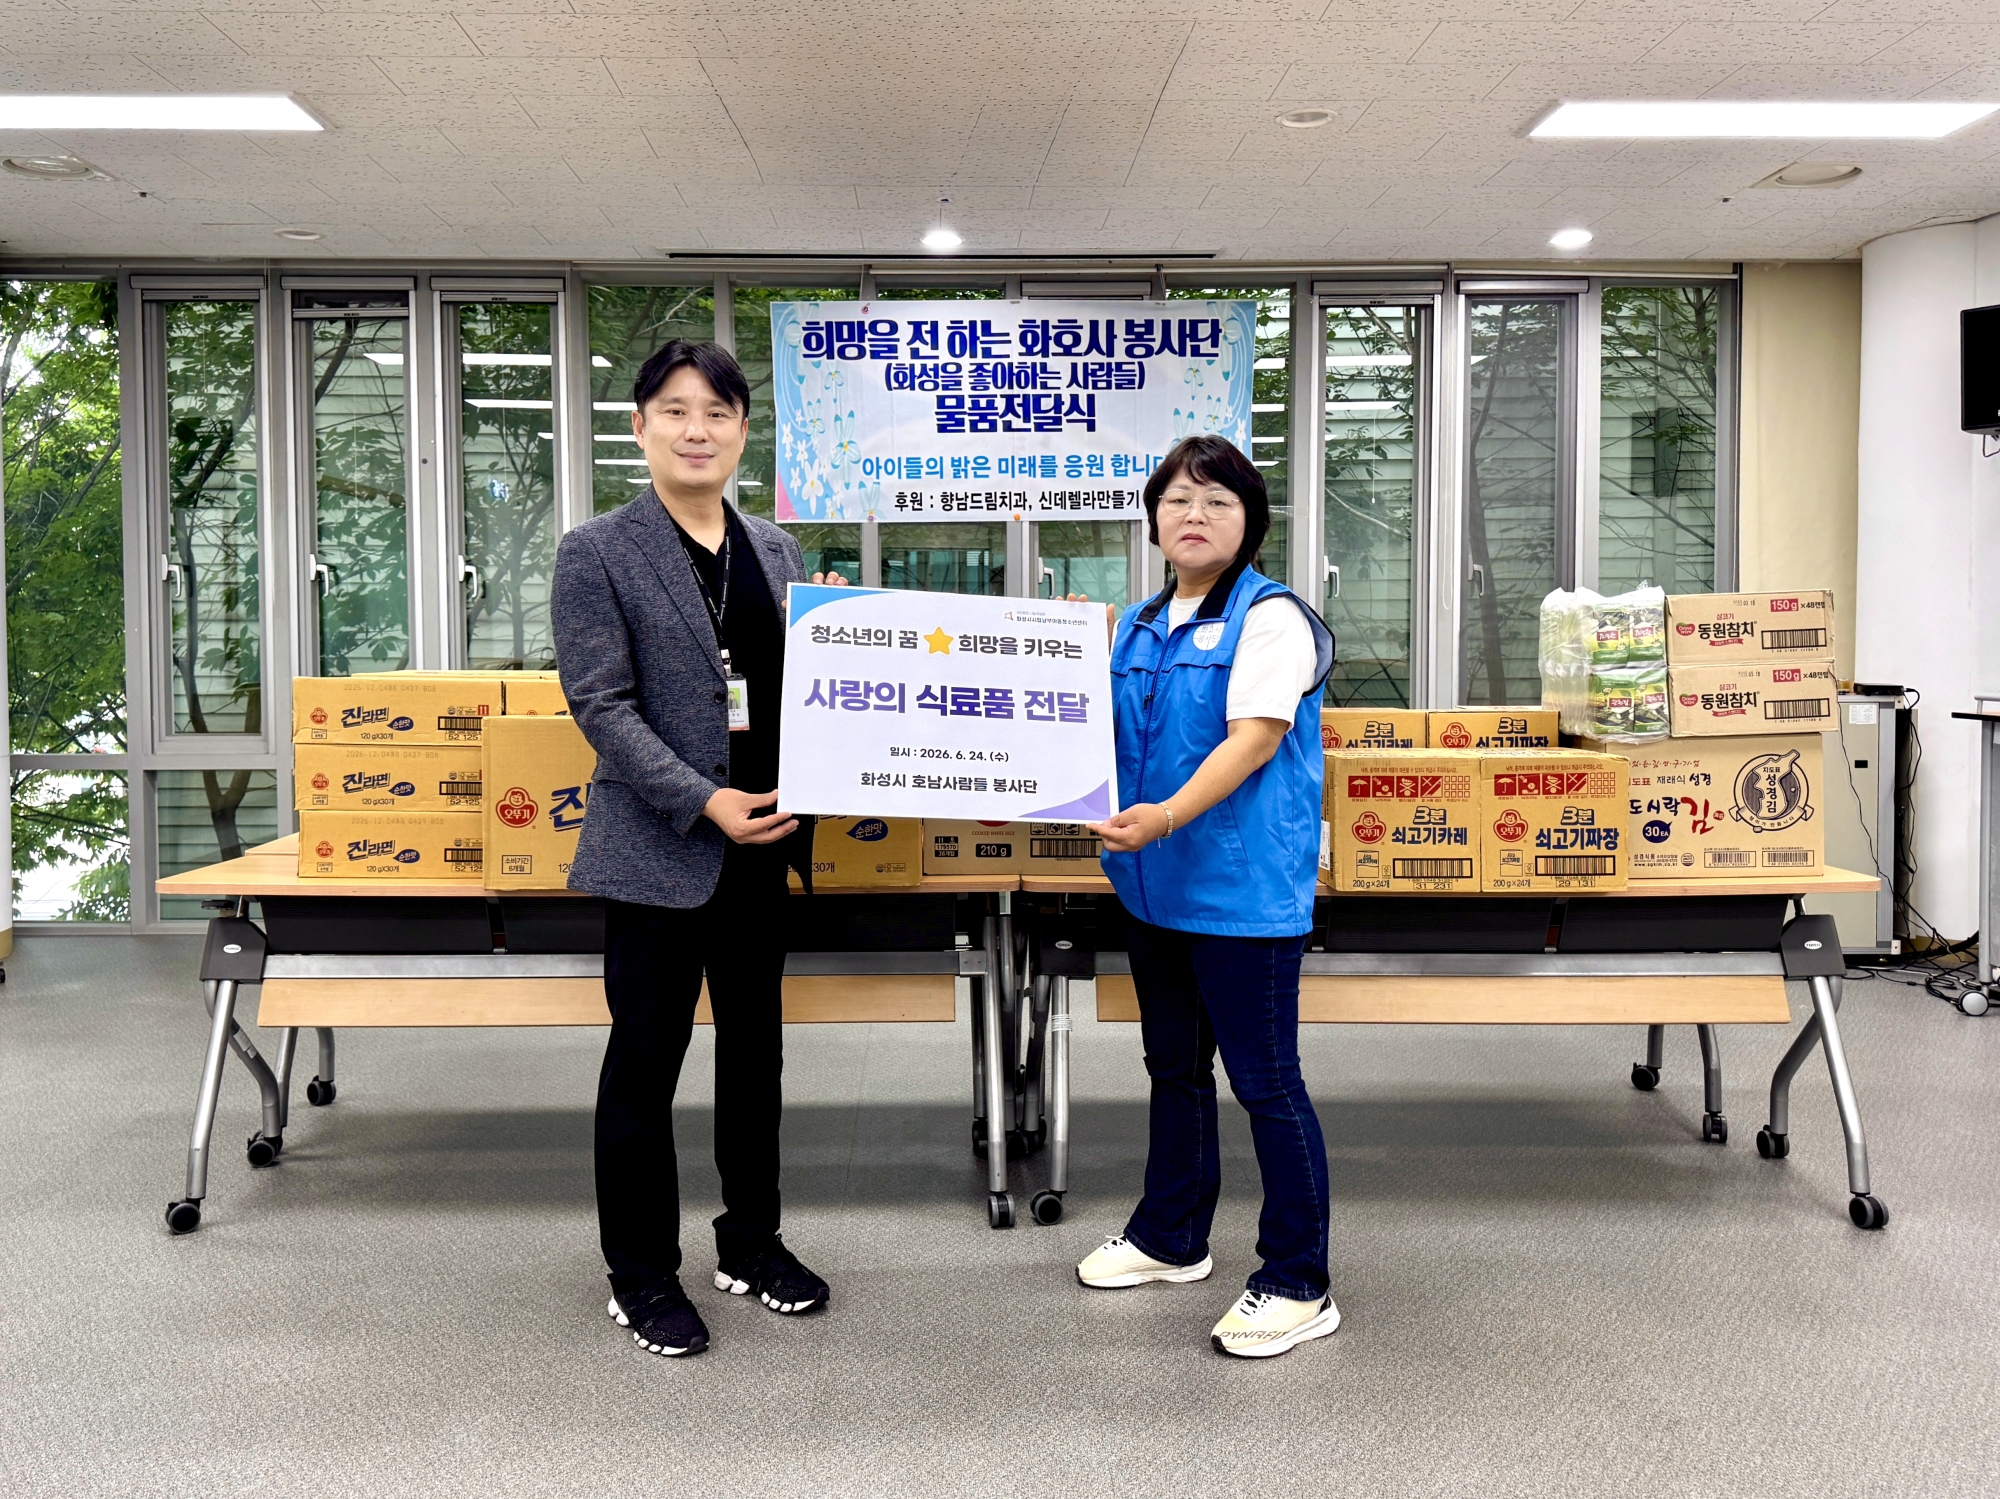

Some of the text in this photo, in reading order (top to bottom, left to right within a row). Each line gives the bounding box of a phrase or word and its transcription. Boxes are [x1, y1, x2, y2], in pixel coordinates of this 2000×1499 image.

[802, 318, 1222, 360] 희망을 전 하는 화호사 봉사단
[884, 361, 1145, 391] (화성을 좋아하는 사람들)
[934, 393, 1096, 433] 물품전달식
[862, 456, 944, 480] 아이들의
[950, 455, 991, 479] 밝은
[998, 455, 1058, 478] 미래를
[1064, 454, 1104, 478] 응원
[894, 491, 923, 512] 후원
[940, 491, 1032, 512] 향남드림치과,
[1038, 490, 1140, 511] 신데렐라만들기
[1772, 601, 1788, 611] 150
[1791, 602, 1797, 612] g
[1698, 621, 1755, 640] 동원참치
[811, 625, 1083, 660] 청소년의 꿈 희망을 키우는
[1774, 671, 1790, 681] 150
[1793, 672, 1800, 682] g
[804, 678, 1090, 723] 사랑의 식료품 전달
[1700, 692, 1757, 709] 동원참치
[341, 706, 390, 729] 진라면
[1497, 717, 1527, 734] 3분
[1364, 721, 1394, 738] 3분
[1322, 740, 1336, 748] 뚜기
[1445, 737, 1466, 747] 오뚜기
[889, 746, 911, 758] 일시
[920, 748, 953, 760] 2026.
[955, 750, 966, 760] 6.
[969, 751, 987, 761] 24.
[990, 751, 1009, 762] (수)
[342, 772, 391, 794] 진라면
[861, 772, 1038, 794] 화성시 호남사람들 봉사단
[1629, 773, 1711, 786] 도표 재래식 성경
[1765, 773, 1778, 814] 성경김
[504, 809, 531, 820] 오뚜기
[1413, 806, 1447, 825] 3분
[1560, 806, 1595, 825] 3분
[1629, 797, 1714, 835] 도시락 김
[855, 822, 883, 840] 순한맛
[1358, 828, 1380, 838] 오뚜기
[1391, 827, 1467, 845] 쇠고기카레
[1500, 827, 1522, 836] 오뚜기
[1535, 828, 1619, 850] 쇠고기짜장
[347, 839, 396, 861] 진라면
[980, 845, 1007, 858] 210 g
[1353, 879, 1365, 888] 200
[1493, 879, 1506, 888] 200
